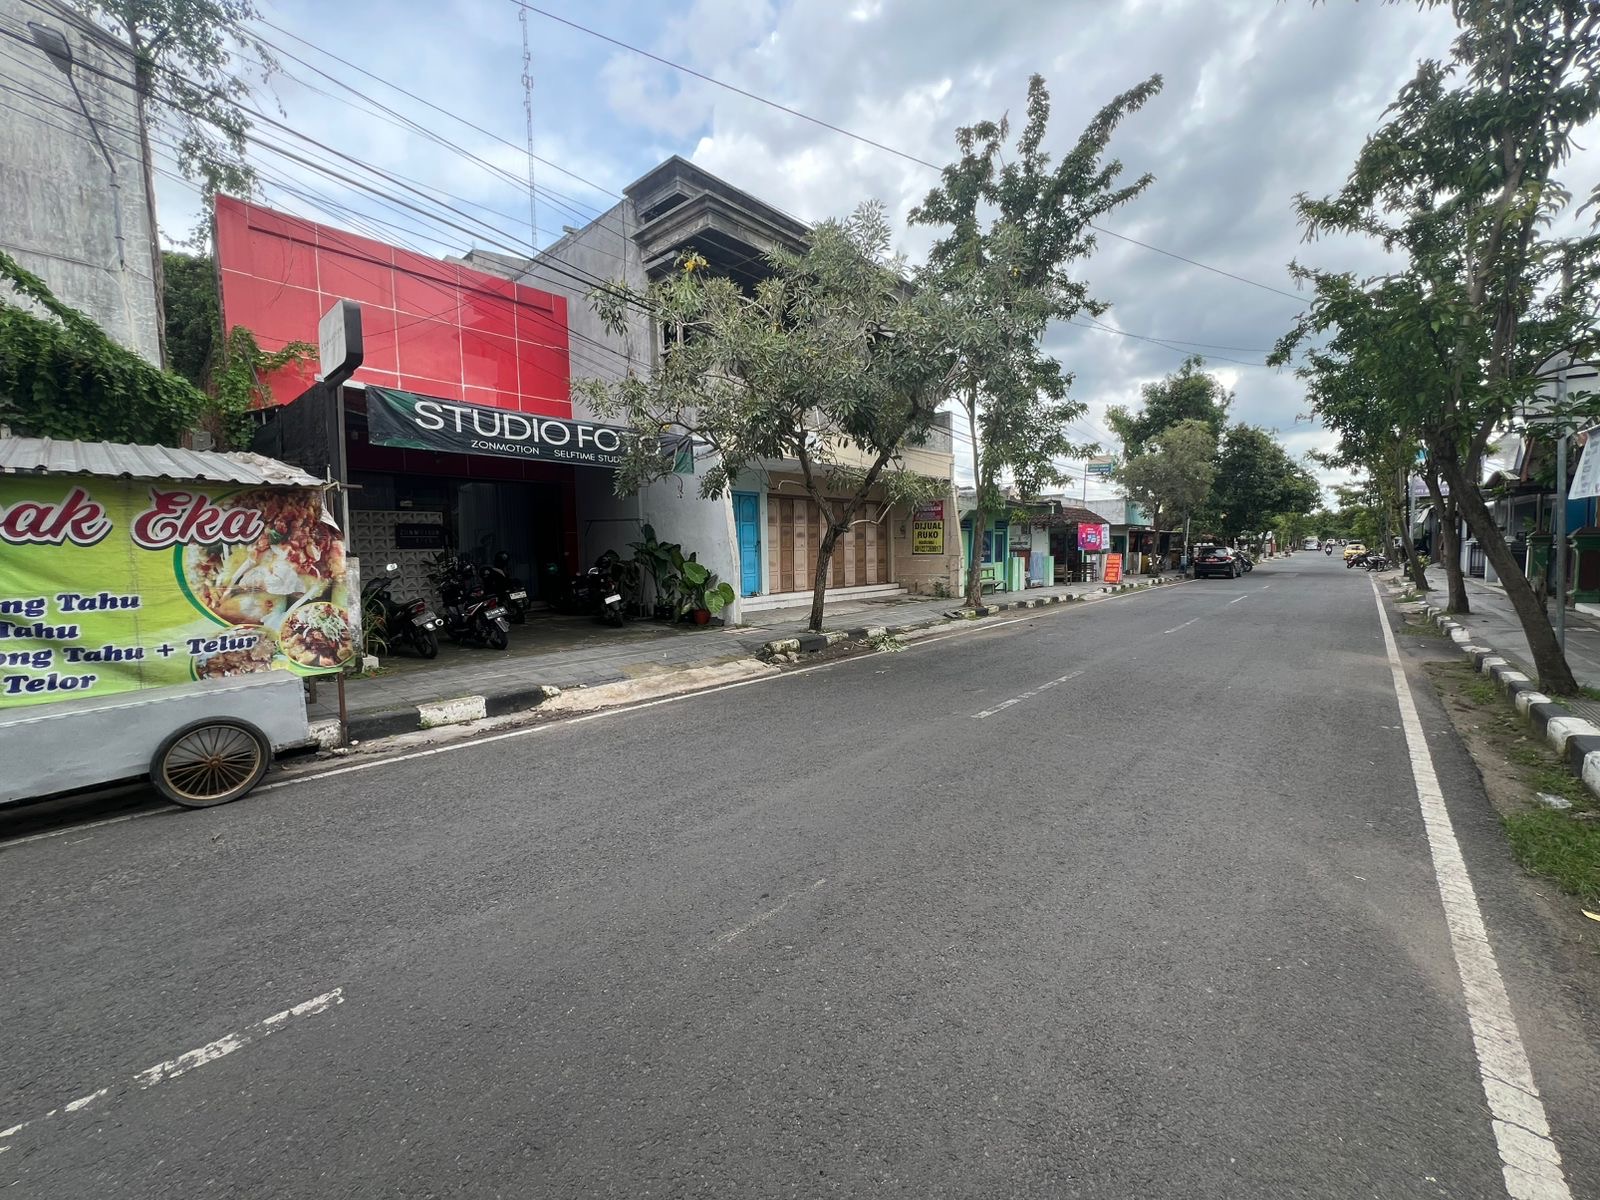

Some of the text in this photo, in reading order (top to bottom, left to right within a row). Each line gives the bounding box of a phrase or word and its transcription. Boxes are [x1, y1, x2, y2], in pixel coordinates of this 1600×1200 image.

[414, 400, 570, 446] STUDIO
[471, 440, 540, 455] ZONMOTION
[554, 449, 595, 462] SELFTIME
[133, 487, 263, 544] Eka
[915, 522, 942, 530] DIJUAL
[917, 531, 939, 539] RUKO
[56, 592, 140, 611] Tahu
[0, 621, 79, 639] Tahu
[63, 645, 144, 662] Tahu
[156, 644, 174, 657] +
[186, 635, 257, 654] Telur
[4, 673, 97, 694] Telor
